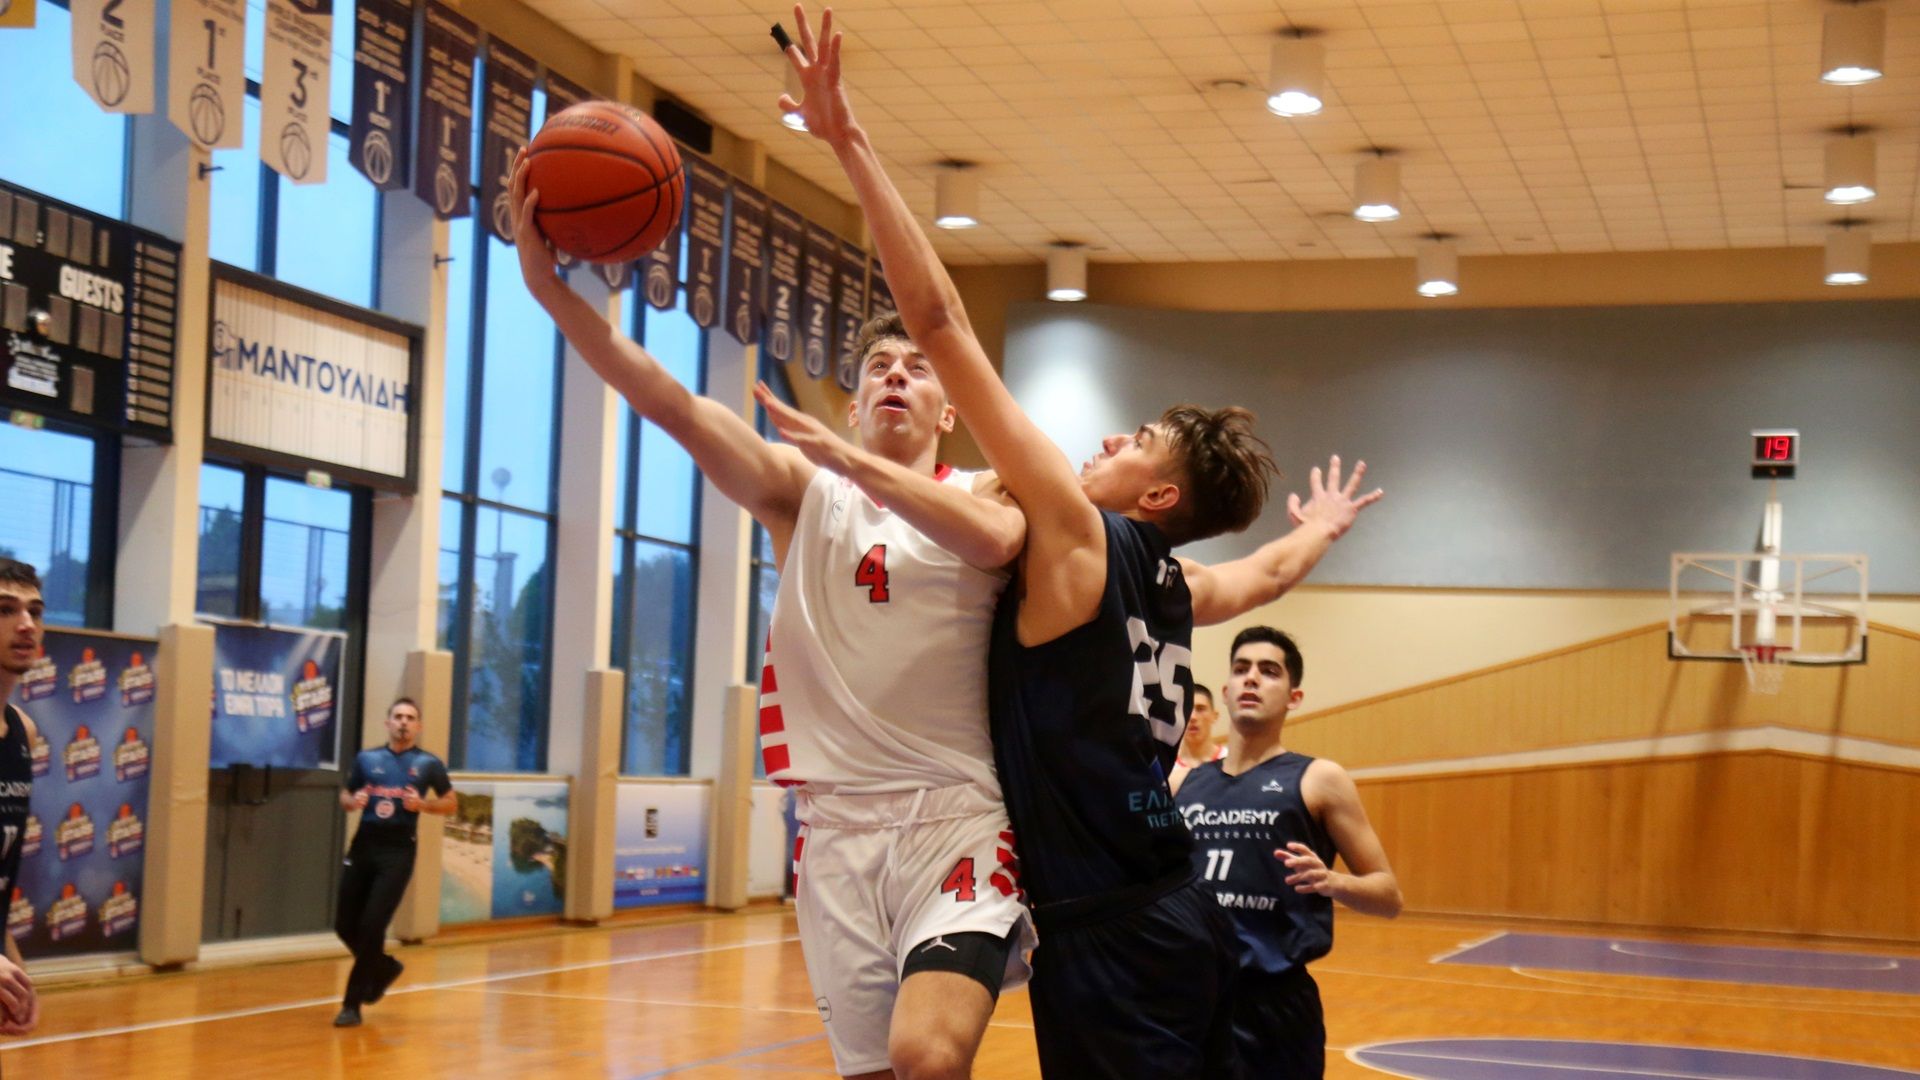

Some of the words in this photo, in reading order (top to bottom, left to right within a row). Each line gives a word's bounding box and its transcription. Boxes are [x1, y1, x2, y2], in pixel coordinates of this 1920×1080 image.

[60, 265, 124, 314] GUESTS
[1764, 436, 1790, 460] 19
[855, 544, 890, 603] 4
[941, 857, 976, 903] 4
[1204, 848, 1234, 881] 11
